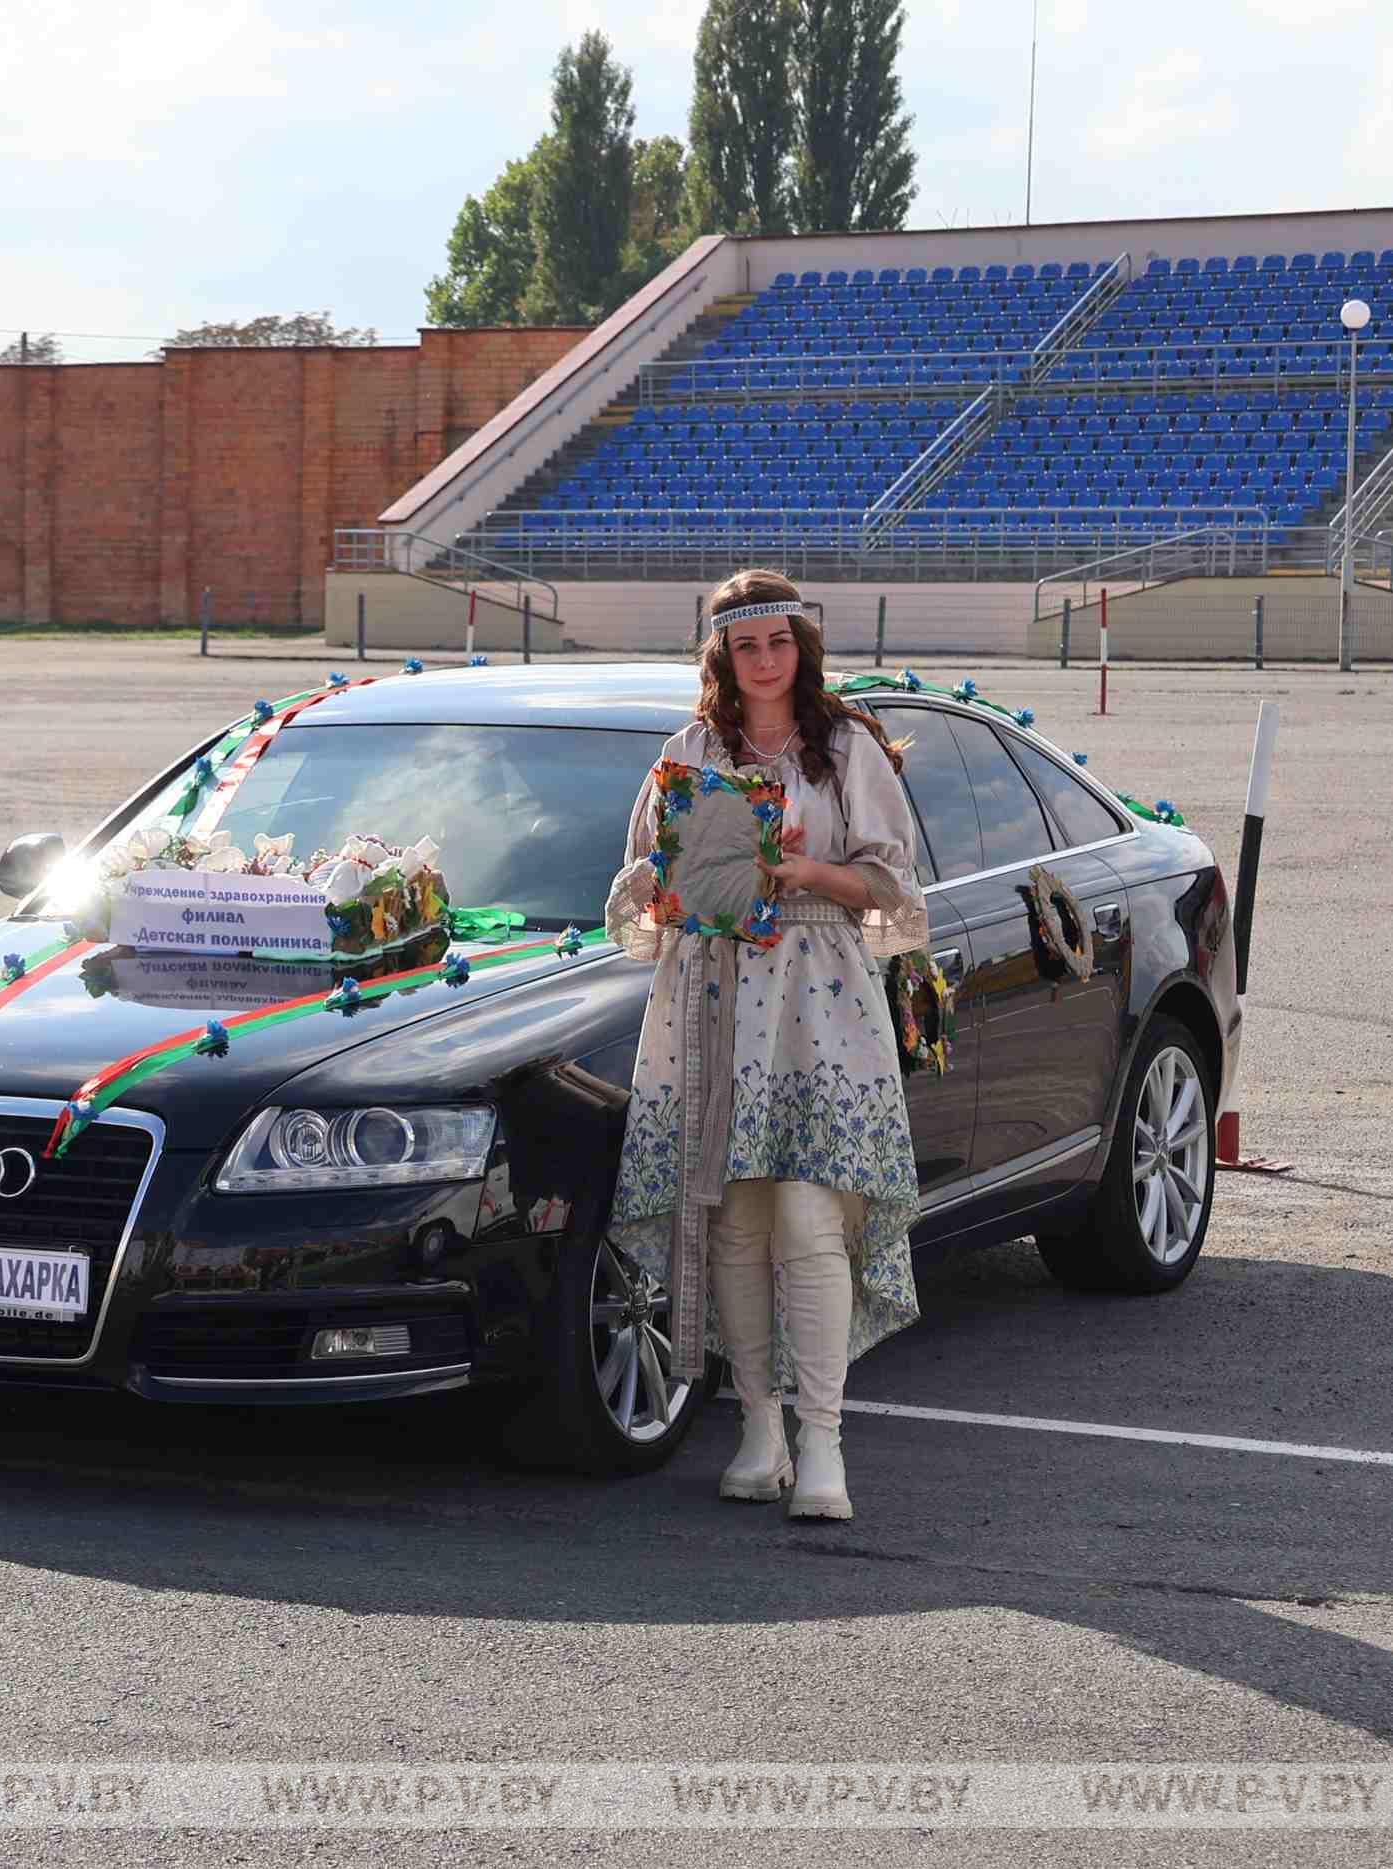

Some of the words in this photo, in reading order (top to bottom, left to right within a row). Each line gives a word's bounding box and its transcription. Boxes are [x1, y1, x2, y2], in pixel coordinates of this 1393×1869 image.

[123, 881, 205, 899] Учреждение
[210, 890, 326, 905] здравохранения
[182, 907, 245, 925] филиал
